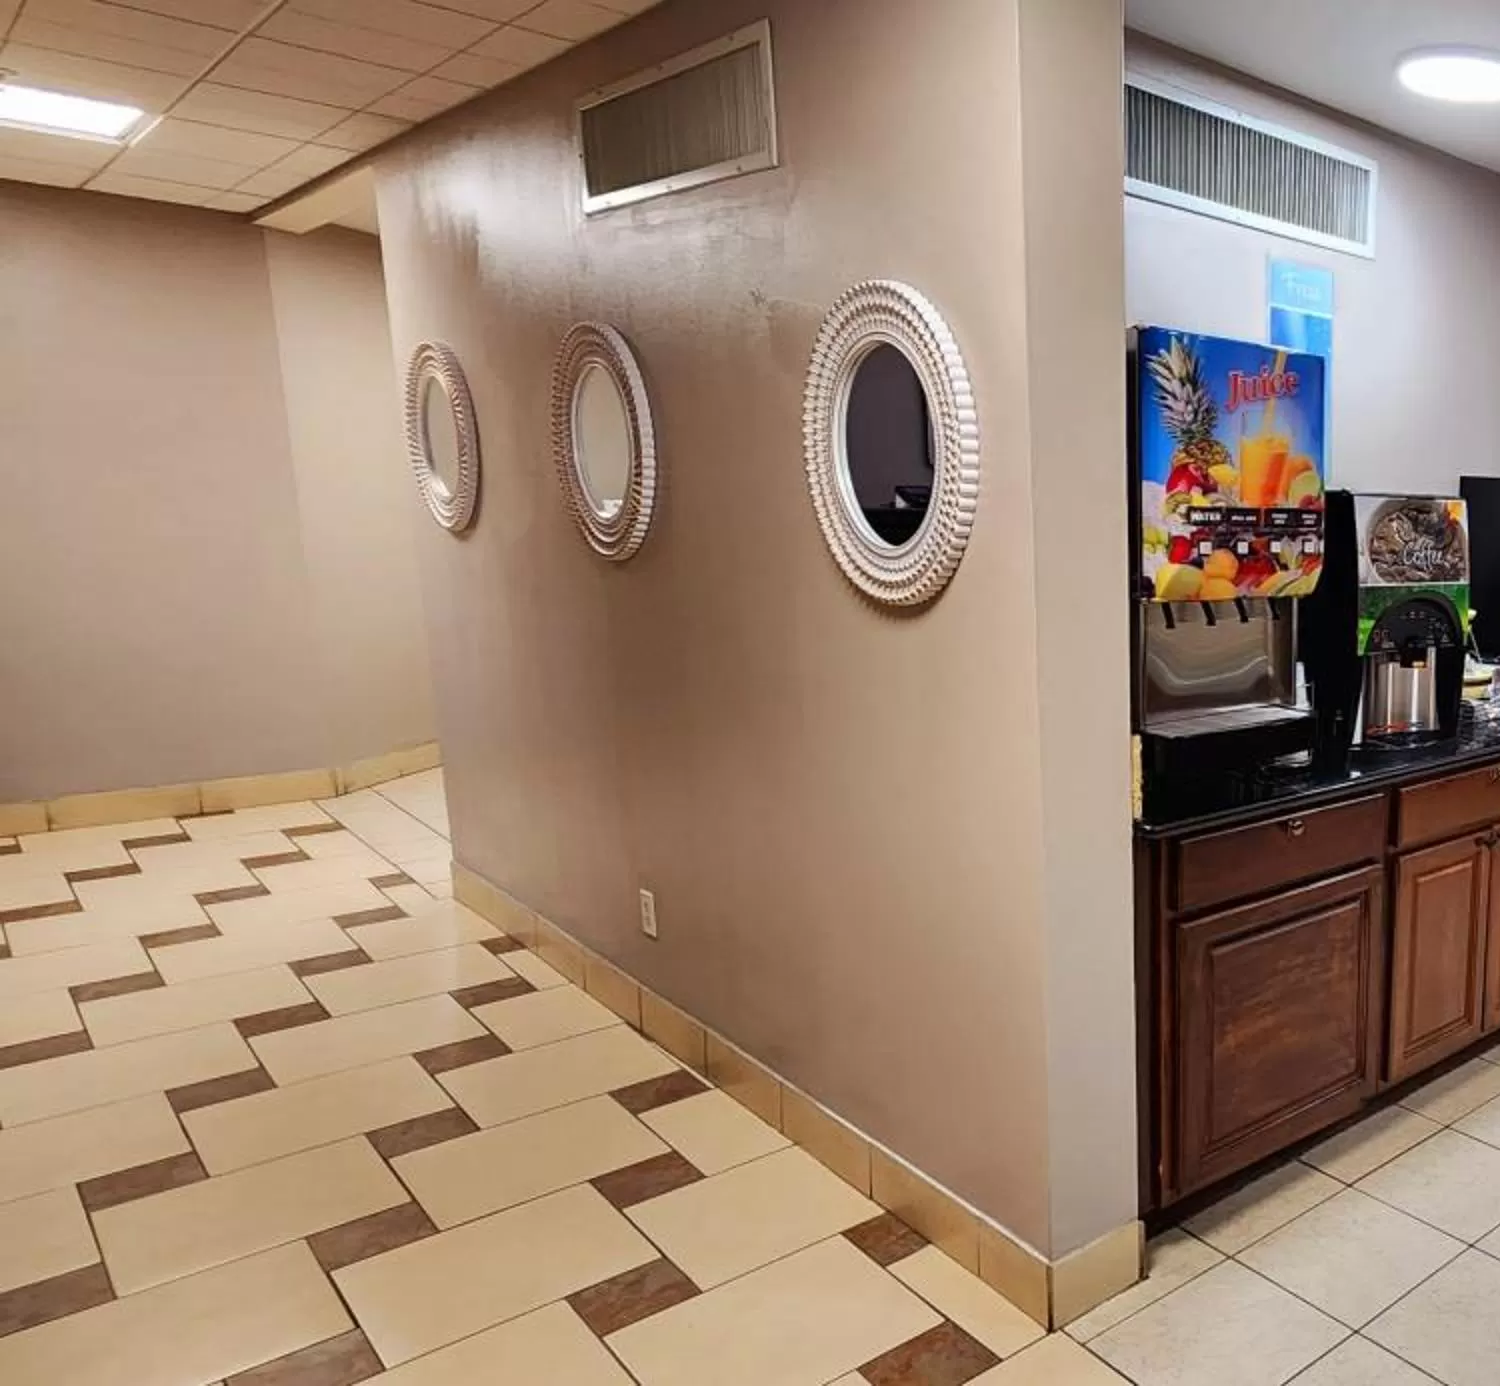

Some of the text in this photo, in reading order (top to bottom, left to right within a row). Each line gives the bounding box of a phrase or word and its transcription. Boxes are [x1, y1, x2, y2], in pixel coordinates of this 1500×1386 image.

[1225, 366, 1299, 412] Juice
[1189, 510, 1221, 523] WATER
[1403, 535, 1446, 571] Coffee
